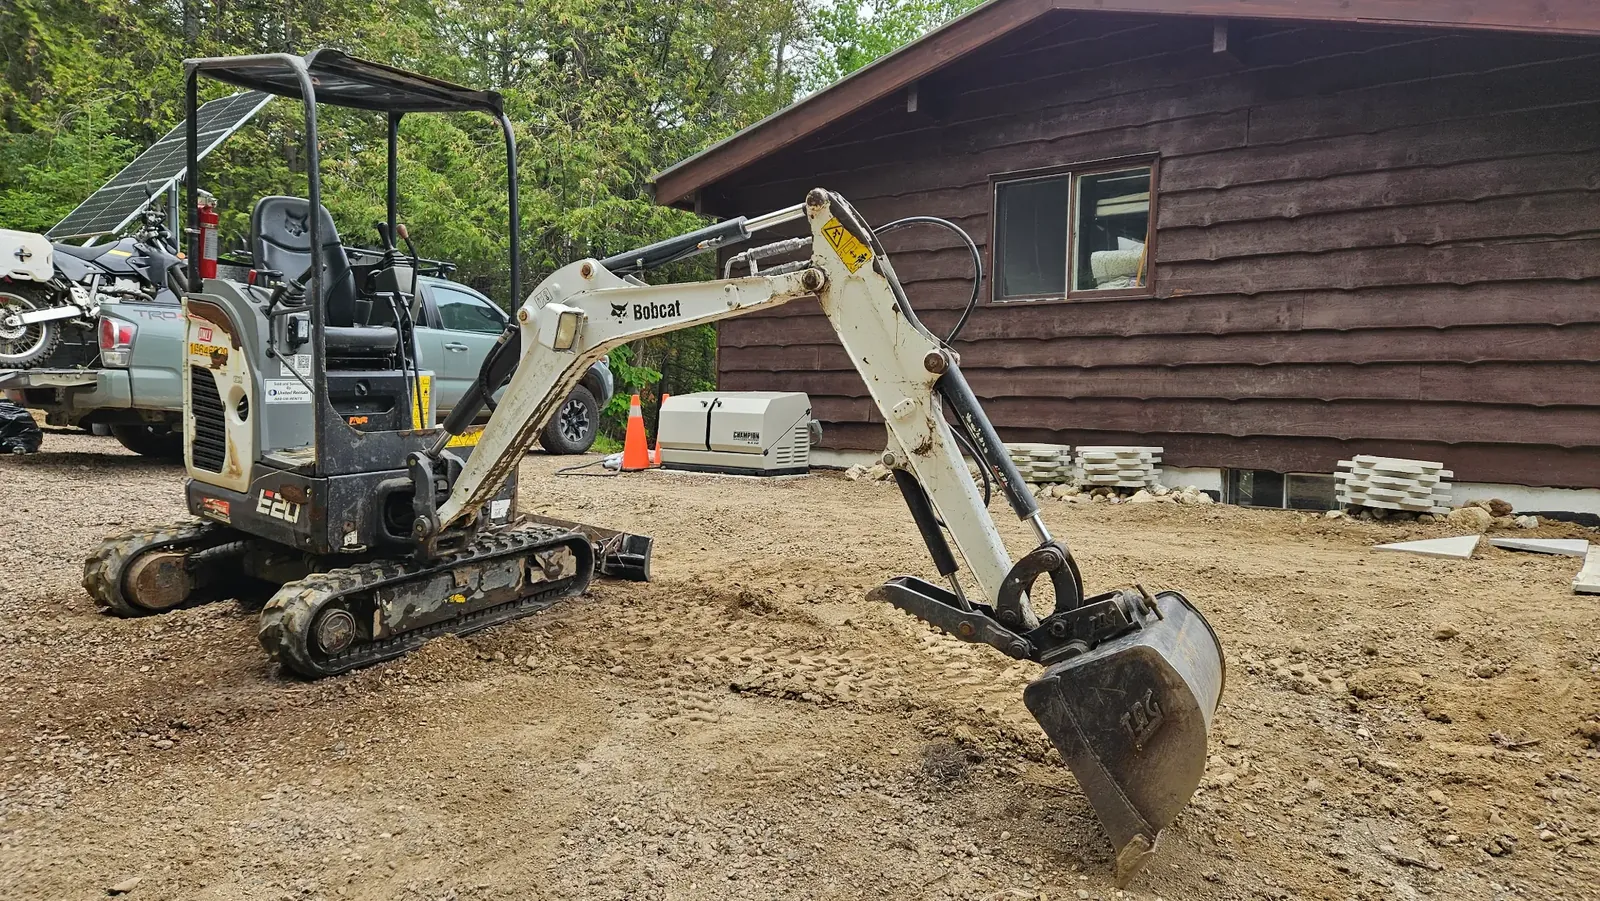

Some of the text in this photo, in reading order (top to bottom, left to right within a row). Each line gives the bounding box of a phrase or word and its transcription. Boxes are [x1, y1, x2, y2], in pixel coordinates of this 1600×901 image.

[133, 309, 177, 321] TRD
[633, 300, 681, 321] Bobcat
[733, 431, 760, 439] CHAMPION
